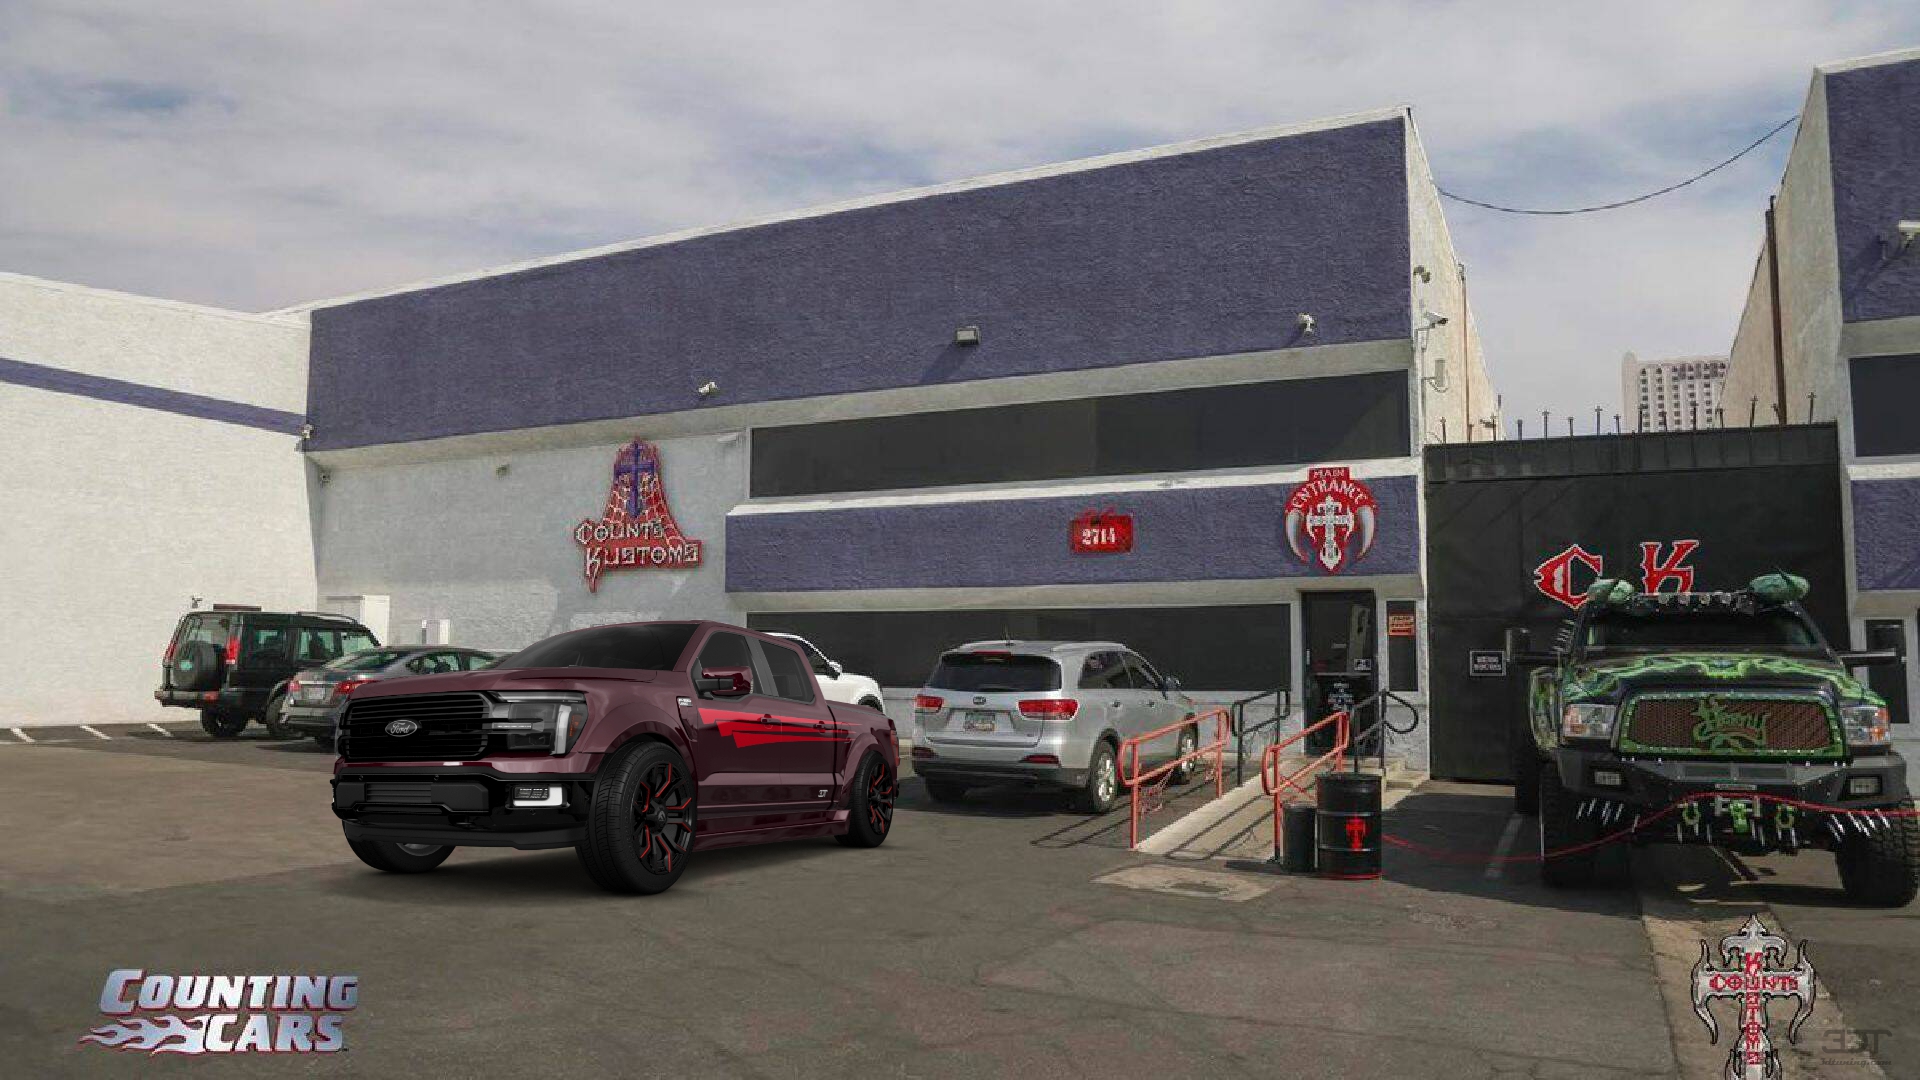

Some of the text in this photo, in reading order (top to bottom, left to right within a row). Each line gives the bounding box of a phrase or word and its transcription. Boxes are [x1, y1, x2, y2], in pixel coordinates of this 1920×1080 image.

[1292, 479, 1367, 508] ENTRANCE
[1082, 527, 1116, 545] 2714
[584, 543, 698, 592] KUSTOMS
[1534, 539, 1700, 609] C K
[390, 722, 411, 734] Ford
